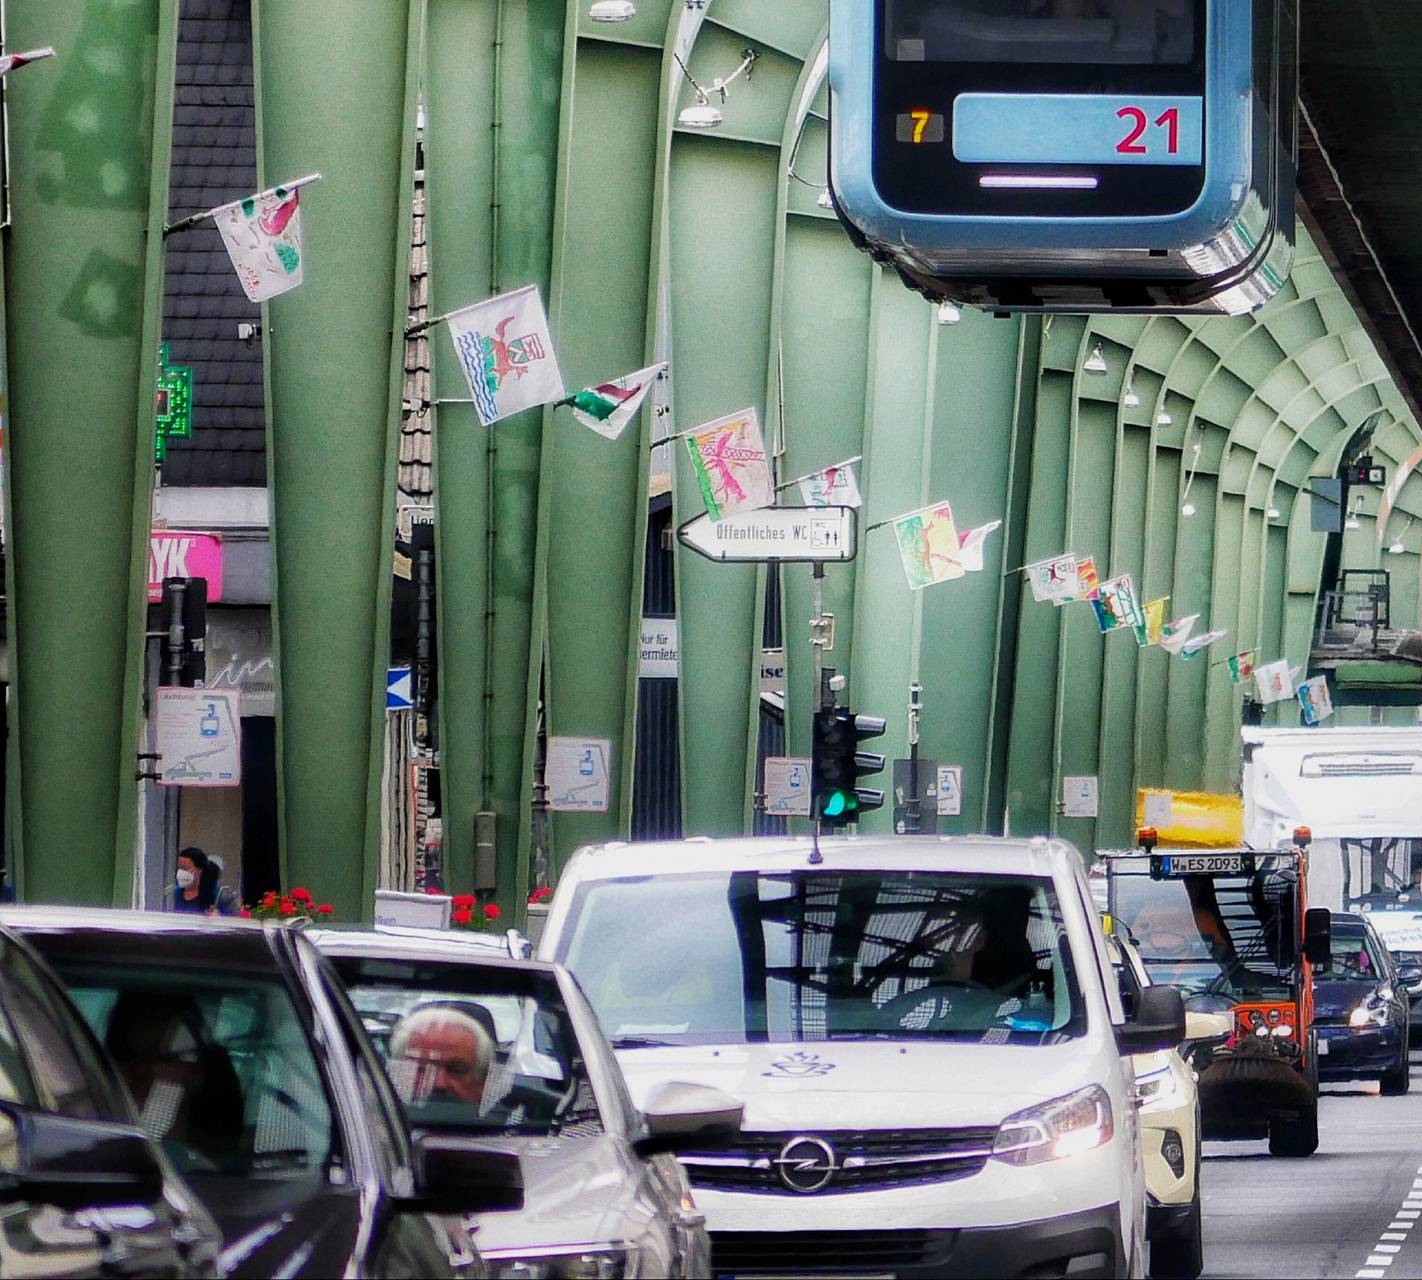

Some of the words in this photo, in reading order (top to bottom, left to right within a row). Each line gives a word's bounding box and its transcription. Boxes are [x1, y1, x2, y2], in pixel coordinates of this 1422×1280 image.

[911, 111, 929, 143] 7
[1115, 106, 1178, 154] 21
[716, 524, 786, 541] Öffentliches
[792, 525, 808, 541] WC
[1207, 857, 1240, 871] 2093
